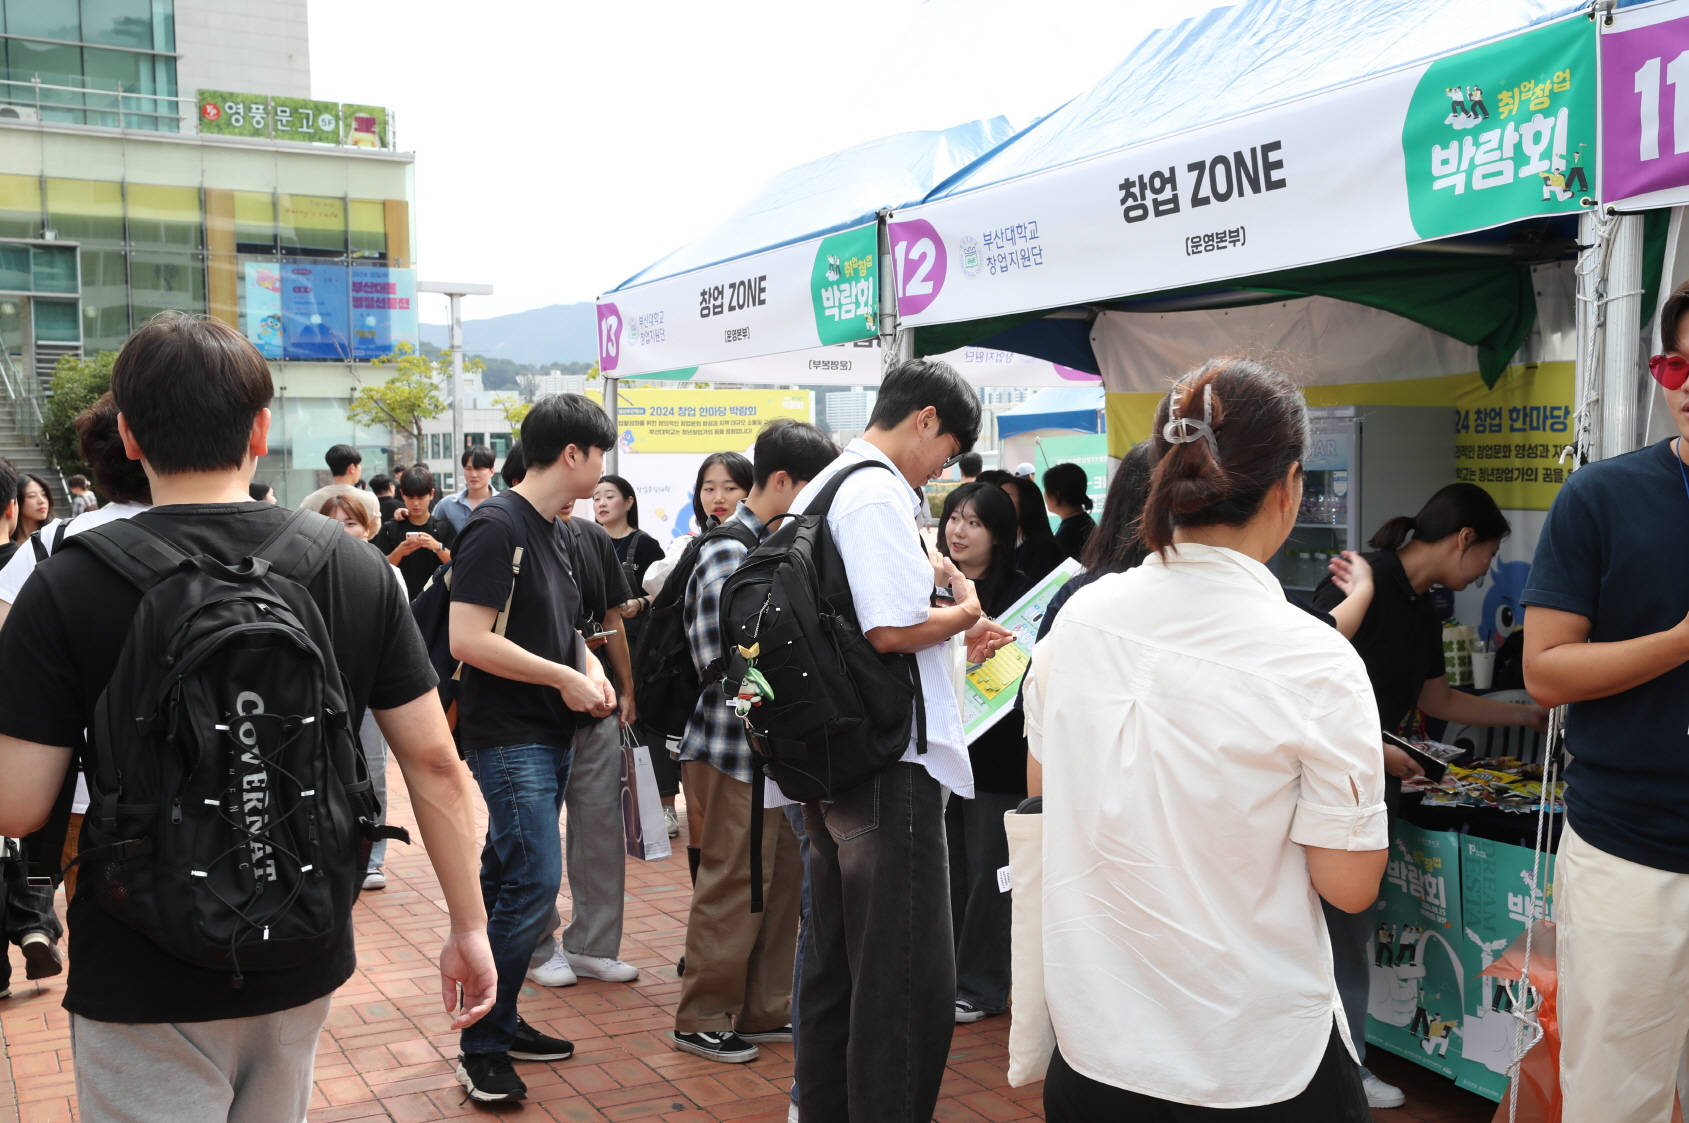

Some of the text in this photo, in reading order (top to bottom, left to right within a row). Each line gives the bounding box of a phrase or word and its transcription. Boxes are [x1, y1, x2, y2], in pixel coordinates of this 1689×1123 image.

[1497, 69, 1571, 119] 취업창업
[1634, 49, 1689, 161] 11
[224, 101, 333, 133] 영풍문고 5F
[1431, 107, 1569, 195] 박람회
[1118, 140, 1287, 224] 창업 ZONE
[983, 220, 1039, 251] 부산대학교
[1185, 226, 1246, 256] (운영본부)
[843, 254, 873, 278] 취업창업
[894, 237, 936, 298] 12
[986, 245, 1043, 276] 창업지원단
[699, 275, 767, 318] 창업 ZONE
[821, 276, 874, 321] 박람회
[638, 310, 664, 328] 부산대학교
[602, 315, 618, 358] 13
[640, 327, 666, 346] 창업지원단
[649, 406, 675, 416] 2024
[677, 406, 696, 417] 창업
[699, 406, 727, 417] 한마당
[729, 405, 757, 416] 박람회
[1474, 407, 1502, 434] 창업
[1508, 405, 1571, 433] 한마당
[1477, 444, 1512, 459] 창업문화
[1514, 443, 1549, 459] 형성과
[1478, 467, 1538, 482] 청년창업가의
[1542, 467, 1563, 483] 꿈을
[236, 690, 277, 882] COVERNAT
[1387, 859, 1447, 908] 박람회
